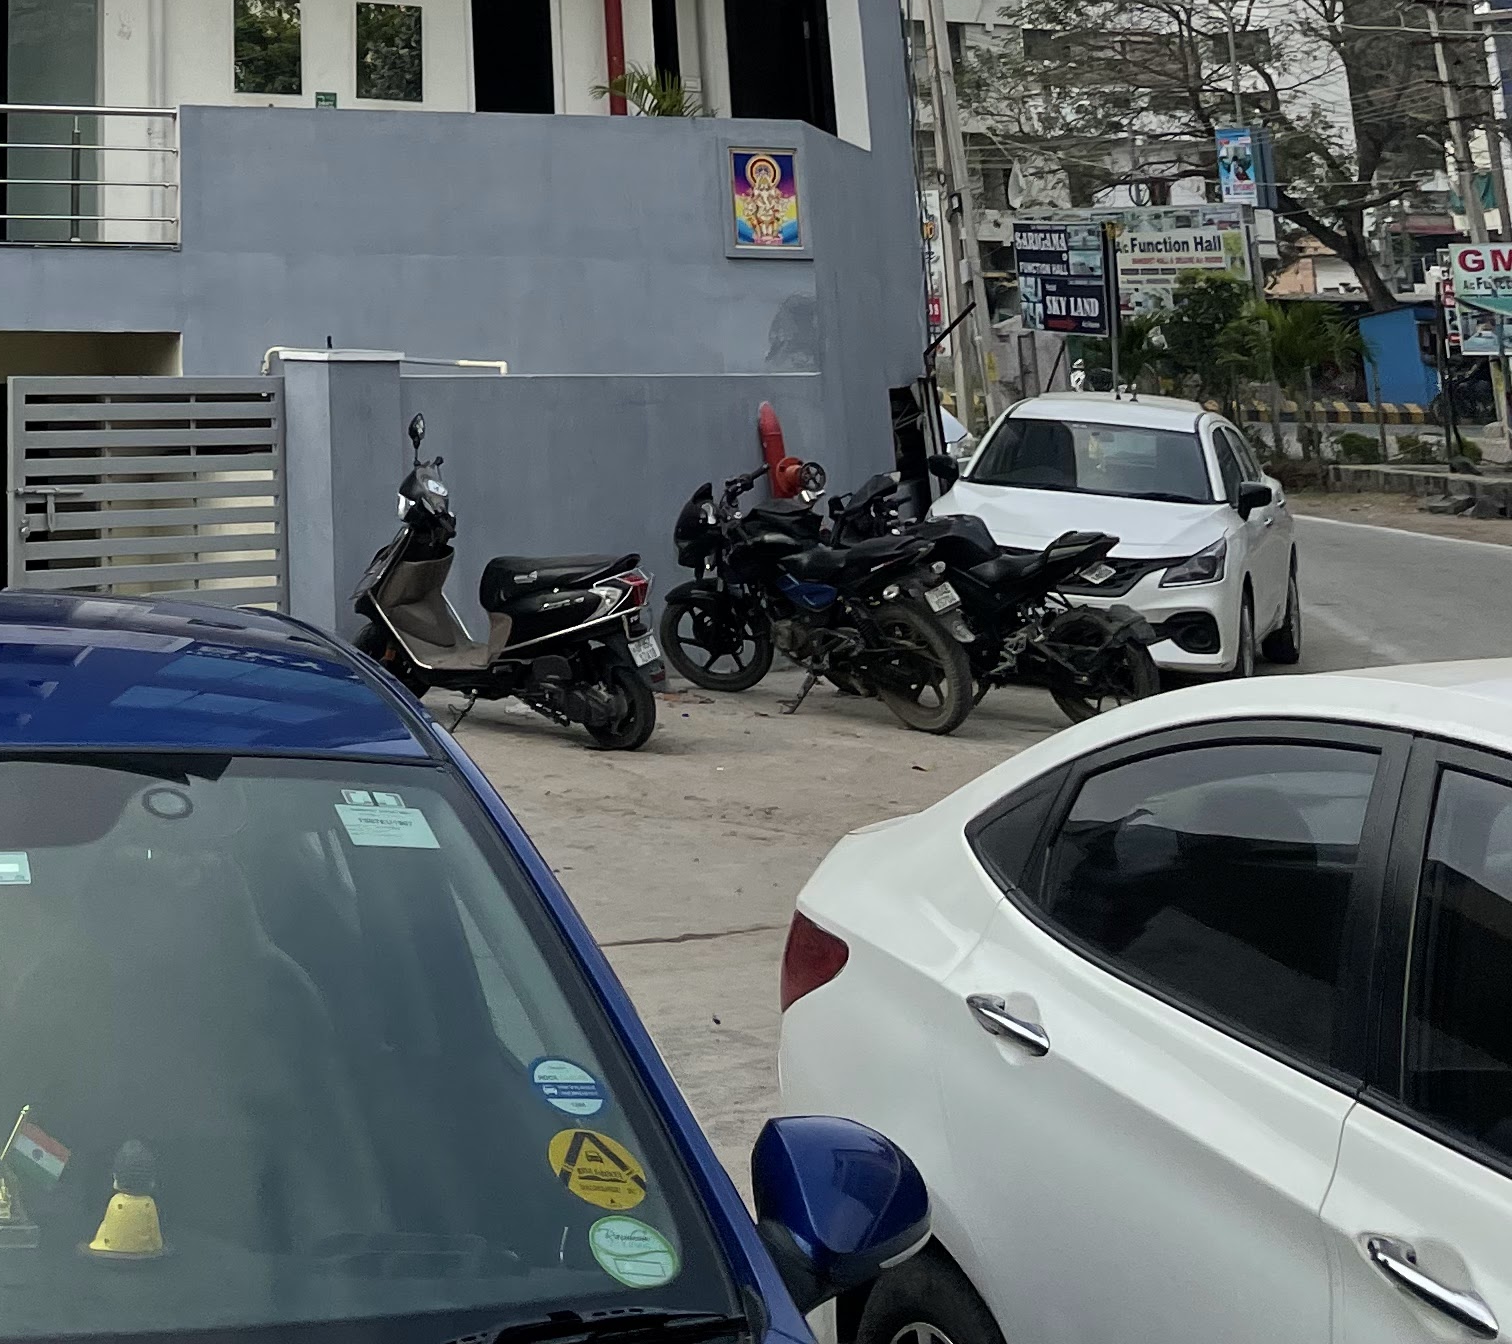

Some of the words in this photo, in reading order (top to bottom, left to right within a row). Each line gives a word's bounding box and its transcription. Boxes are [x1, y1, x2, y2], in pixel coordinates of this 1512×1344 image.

[1130, 236, 1190, 253] Function
[1193, 235, 1222, 252] Hall
[1045, 295, 1067, 316] SKY
[1069, 297, 1100, 318] LAND
